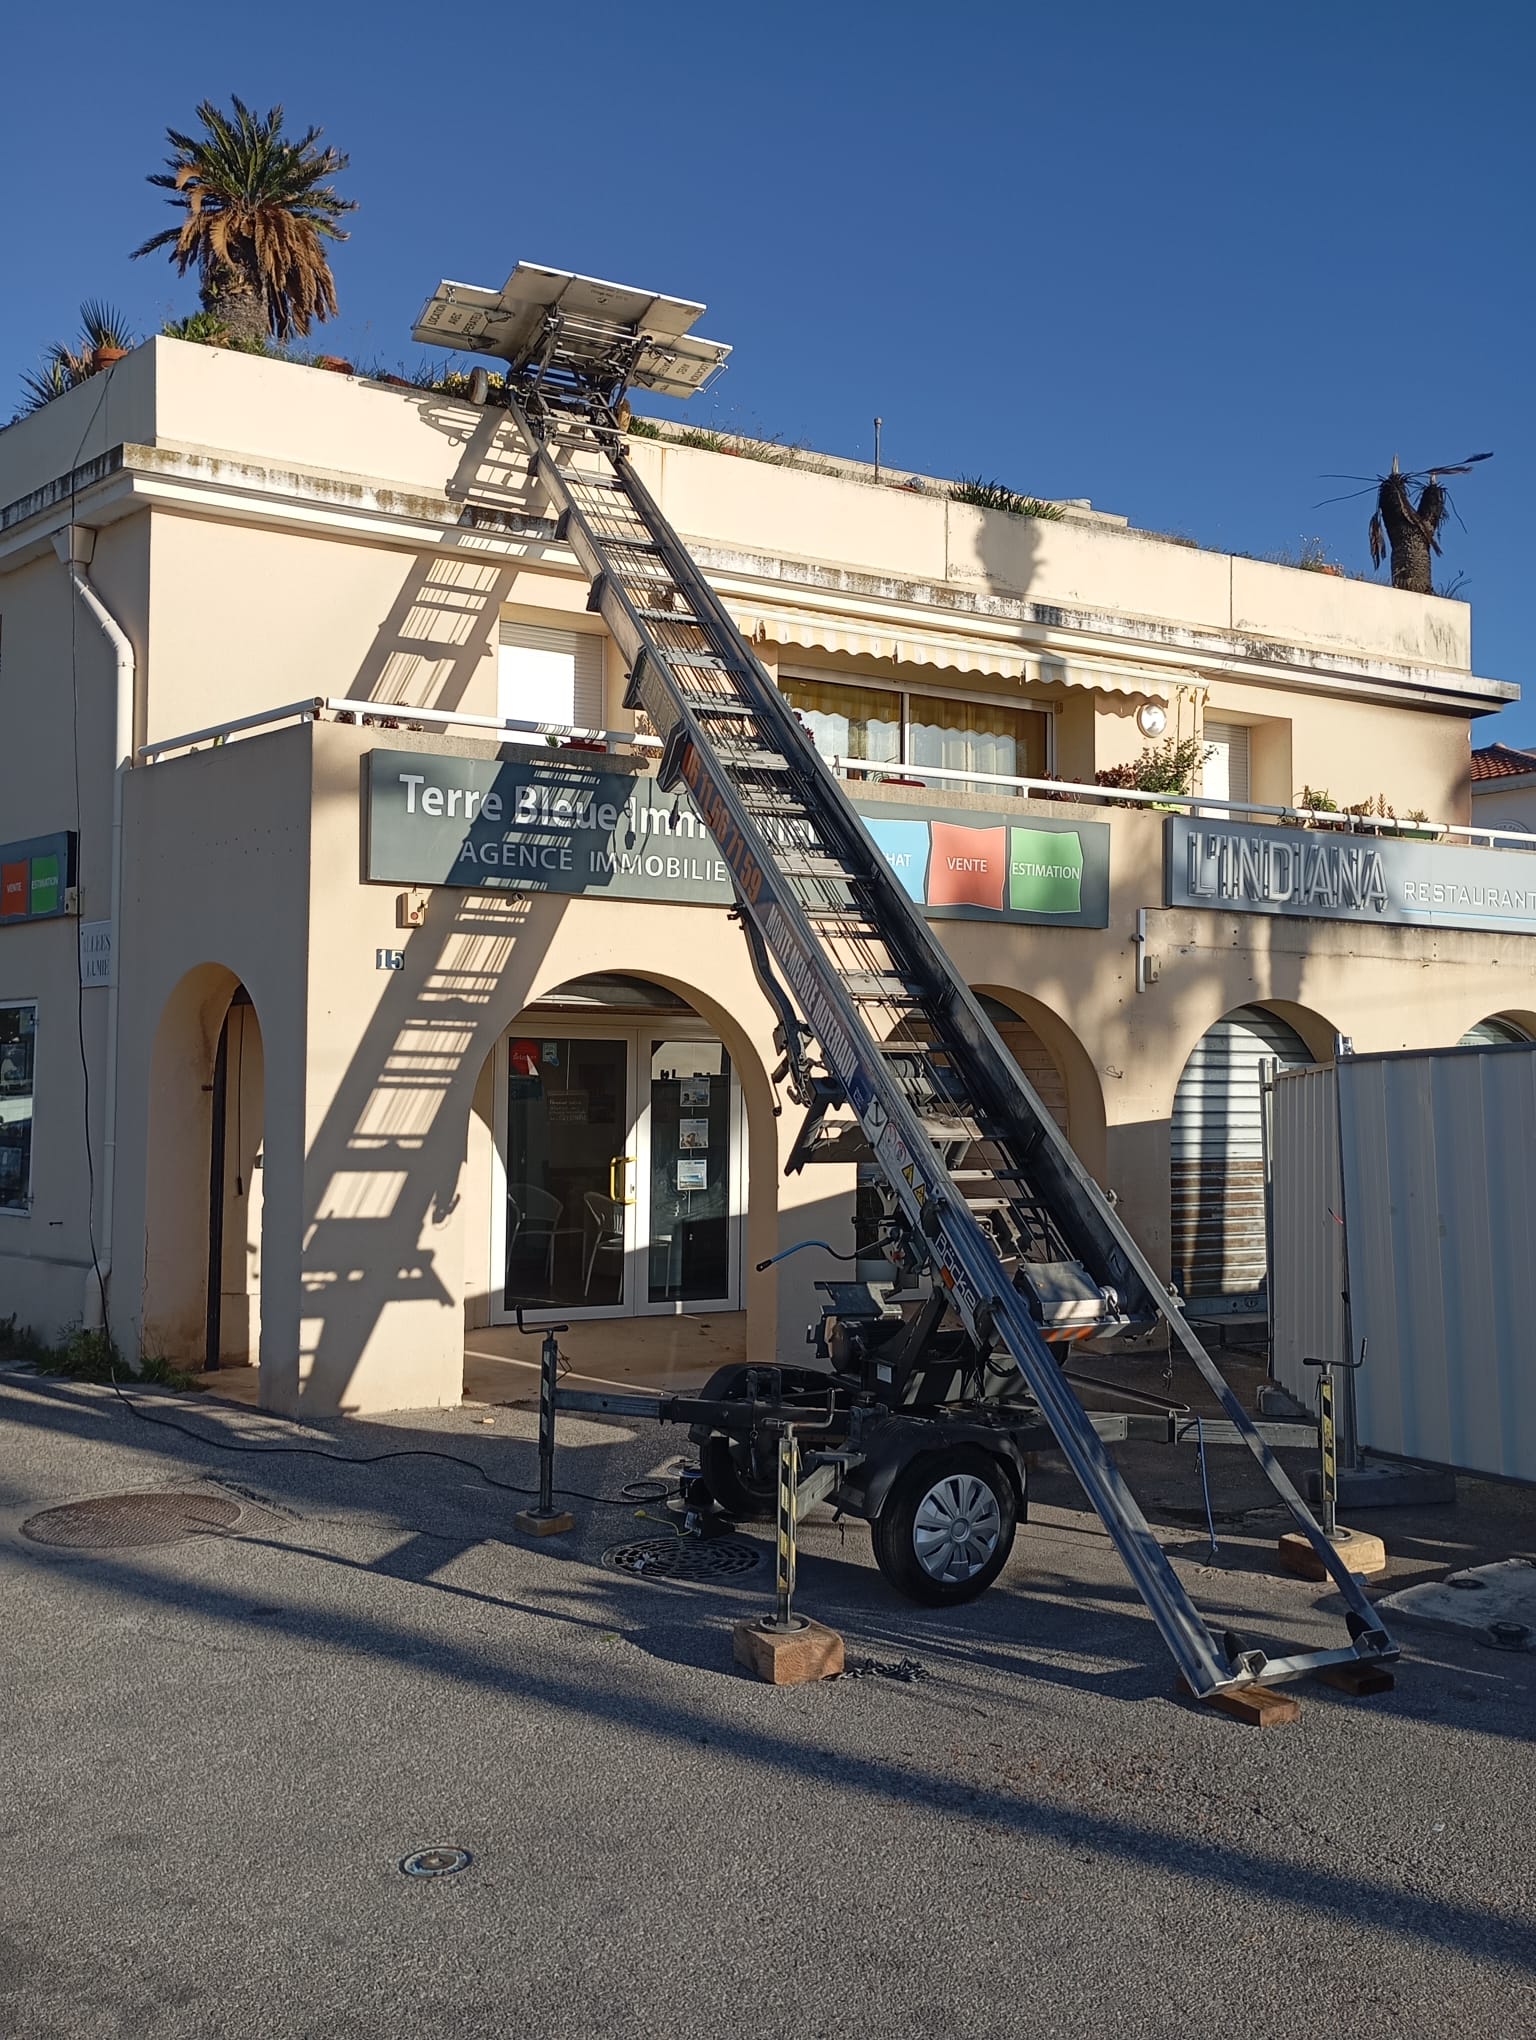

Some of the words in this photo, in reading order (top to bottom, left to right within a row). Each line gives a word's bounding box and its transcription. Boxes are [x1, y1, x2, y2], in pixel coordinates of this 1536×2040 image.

[399, 773, 503, 822] Terre
[515, 784, 617, 832] Bleue
[698, 771, 715, 813] 11
[738, 854, 763, 904] 59
[458, 840, 574, 872] AGENCE
[589, 850, 732, 884] IMMOBILIE
[883, 852, 913, 868] HAT
[945, 856, 988, 873] VENTE
[1011, 861, 1081, 881] ESTIMATION
[1186, 830, 1390, 913] L'INDIANA
[379, 949, 404, 970] 15
